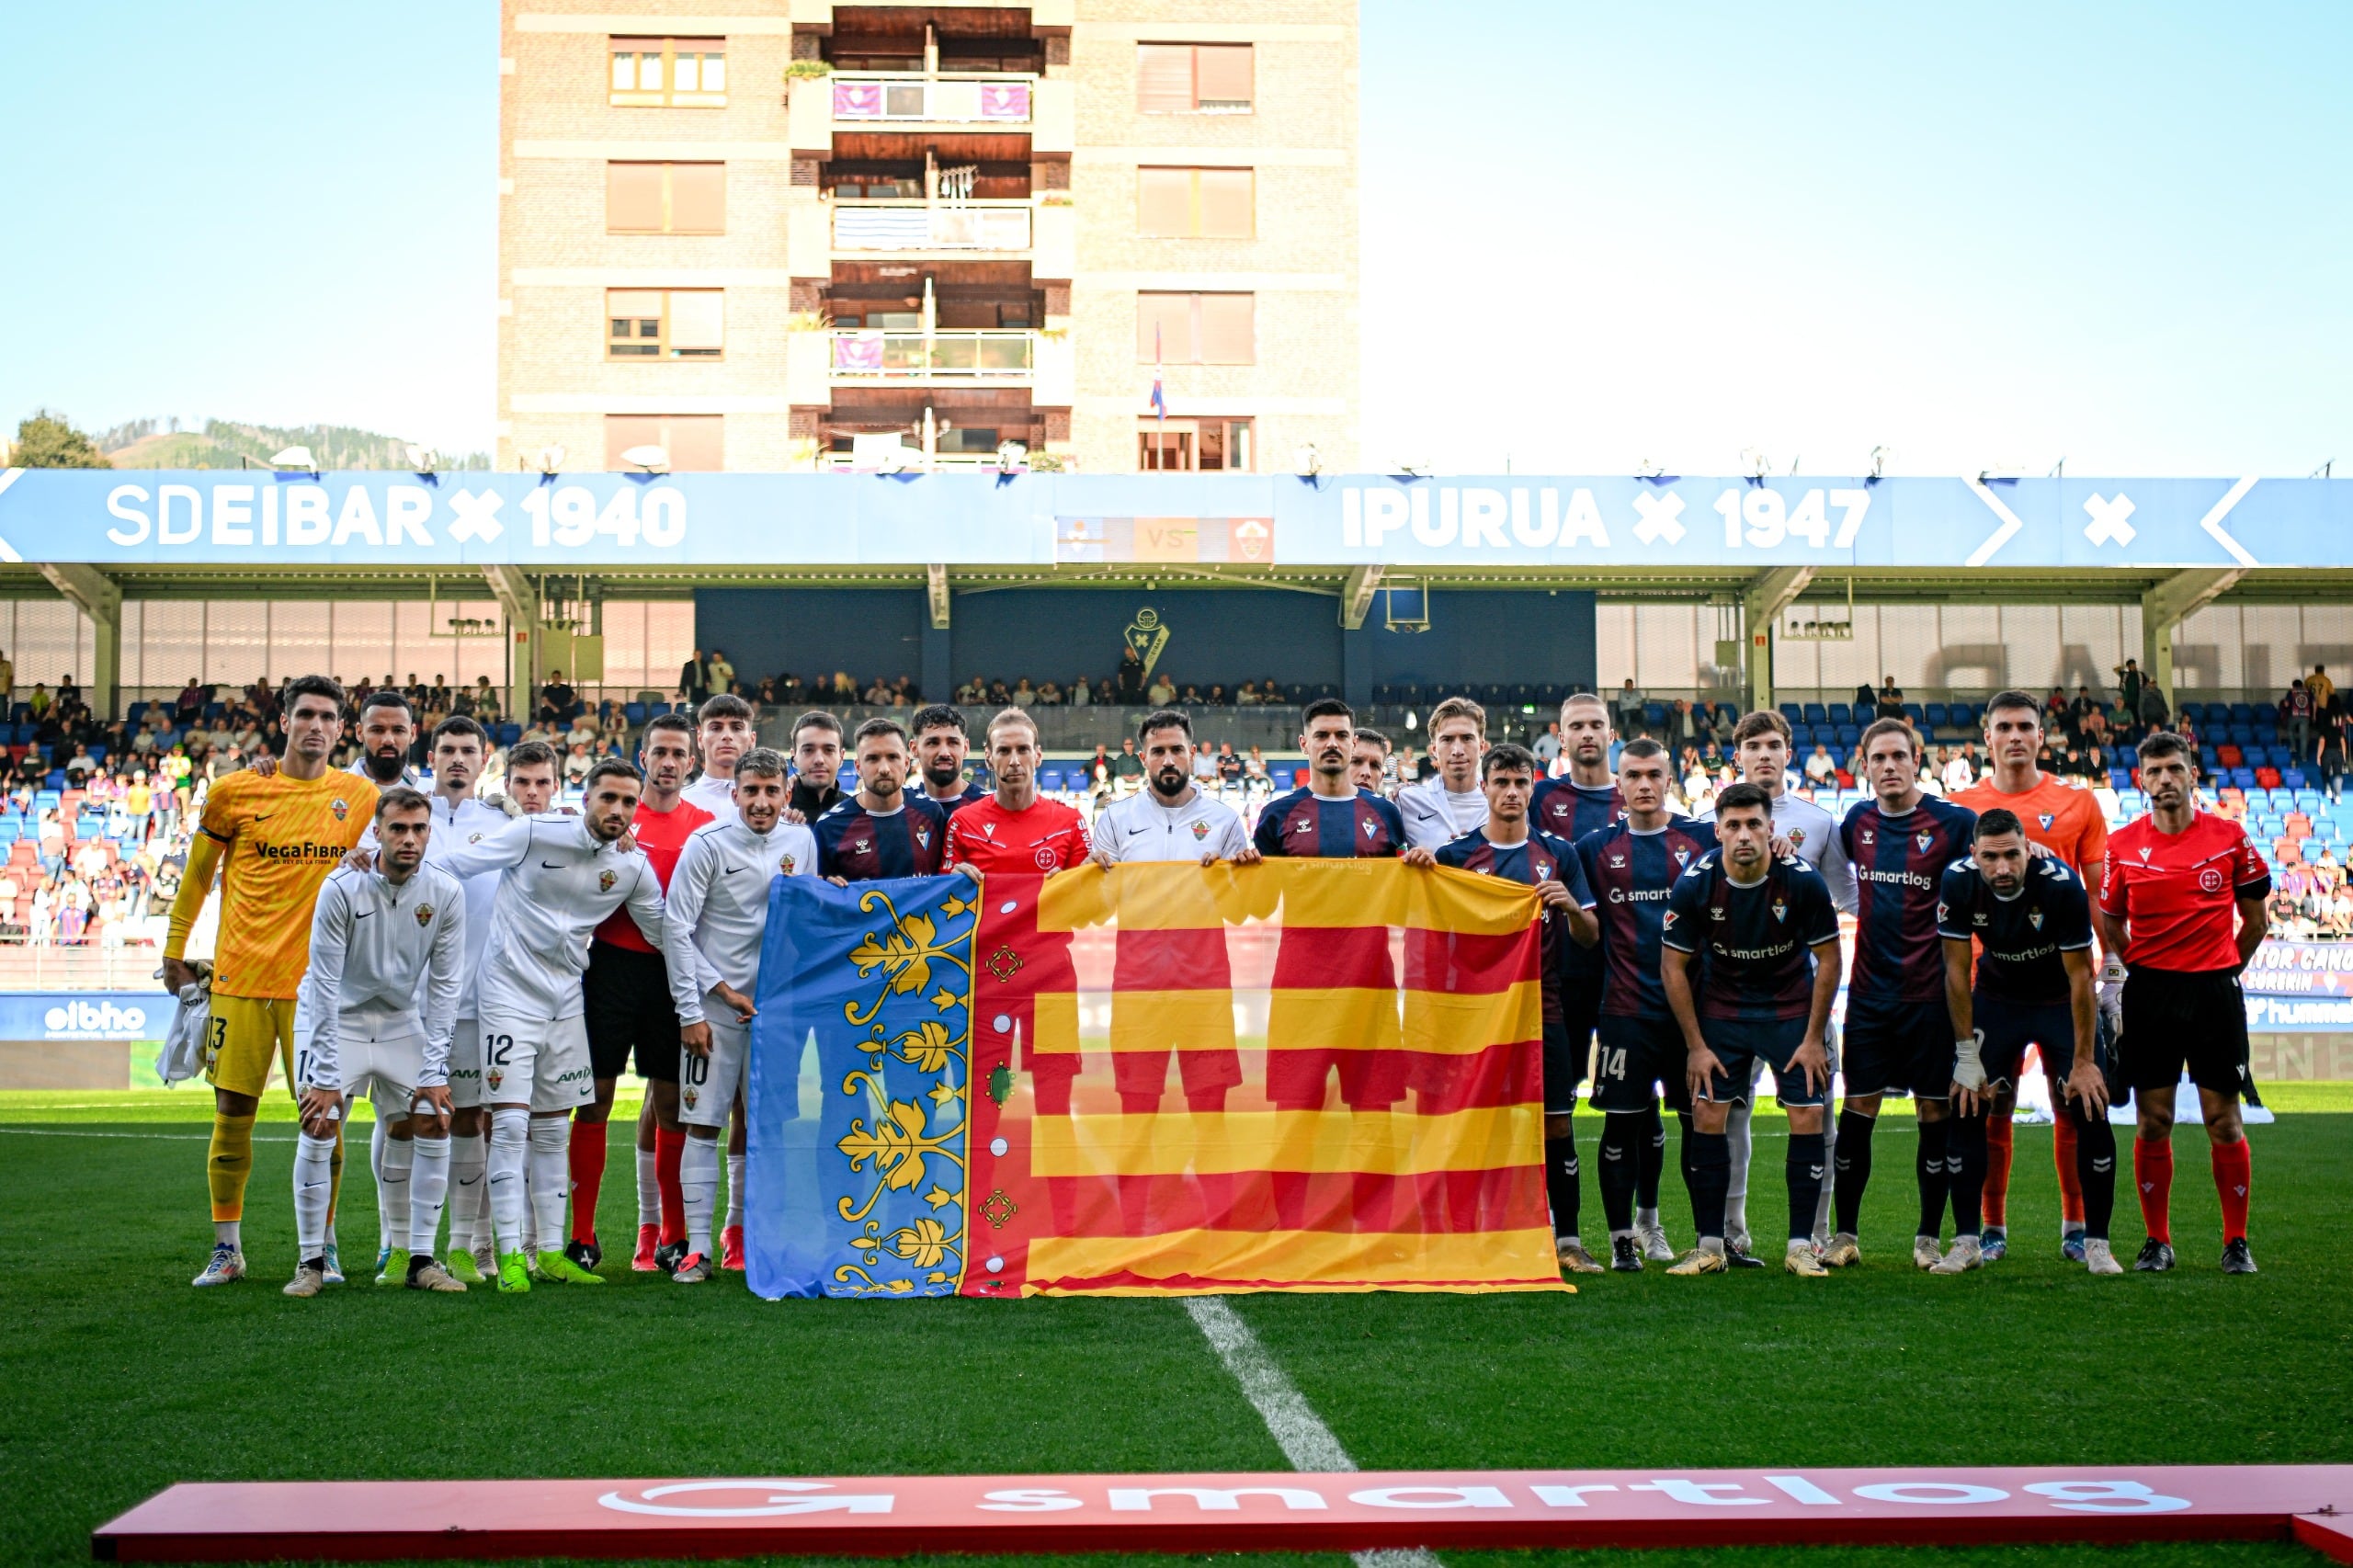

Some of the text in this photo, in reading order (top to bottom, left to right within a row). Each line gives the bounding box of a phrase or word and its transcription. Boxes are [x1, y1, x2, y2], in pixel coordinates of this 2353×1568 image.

[520, 485, 687, 549] 1940
[1341, 487, 1871, 549] IPURUA 1947
[1147, 528, 1185, 550] VS
[1628, 887, 1673, 902] smart
[1870, 868, 1932, 890] smartlog
[1730, 938, 1794, 960] smartlog
[208, 1016, 228, 1050] 13
[485, 1034, 514, 1066] 12
[1601, 1046, 1627, 1081] 14
[684, 1052, 710, 1085] 10
[974, 1474, 2193, 1514] smartlog
